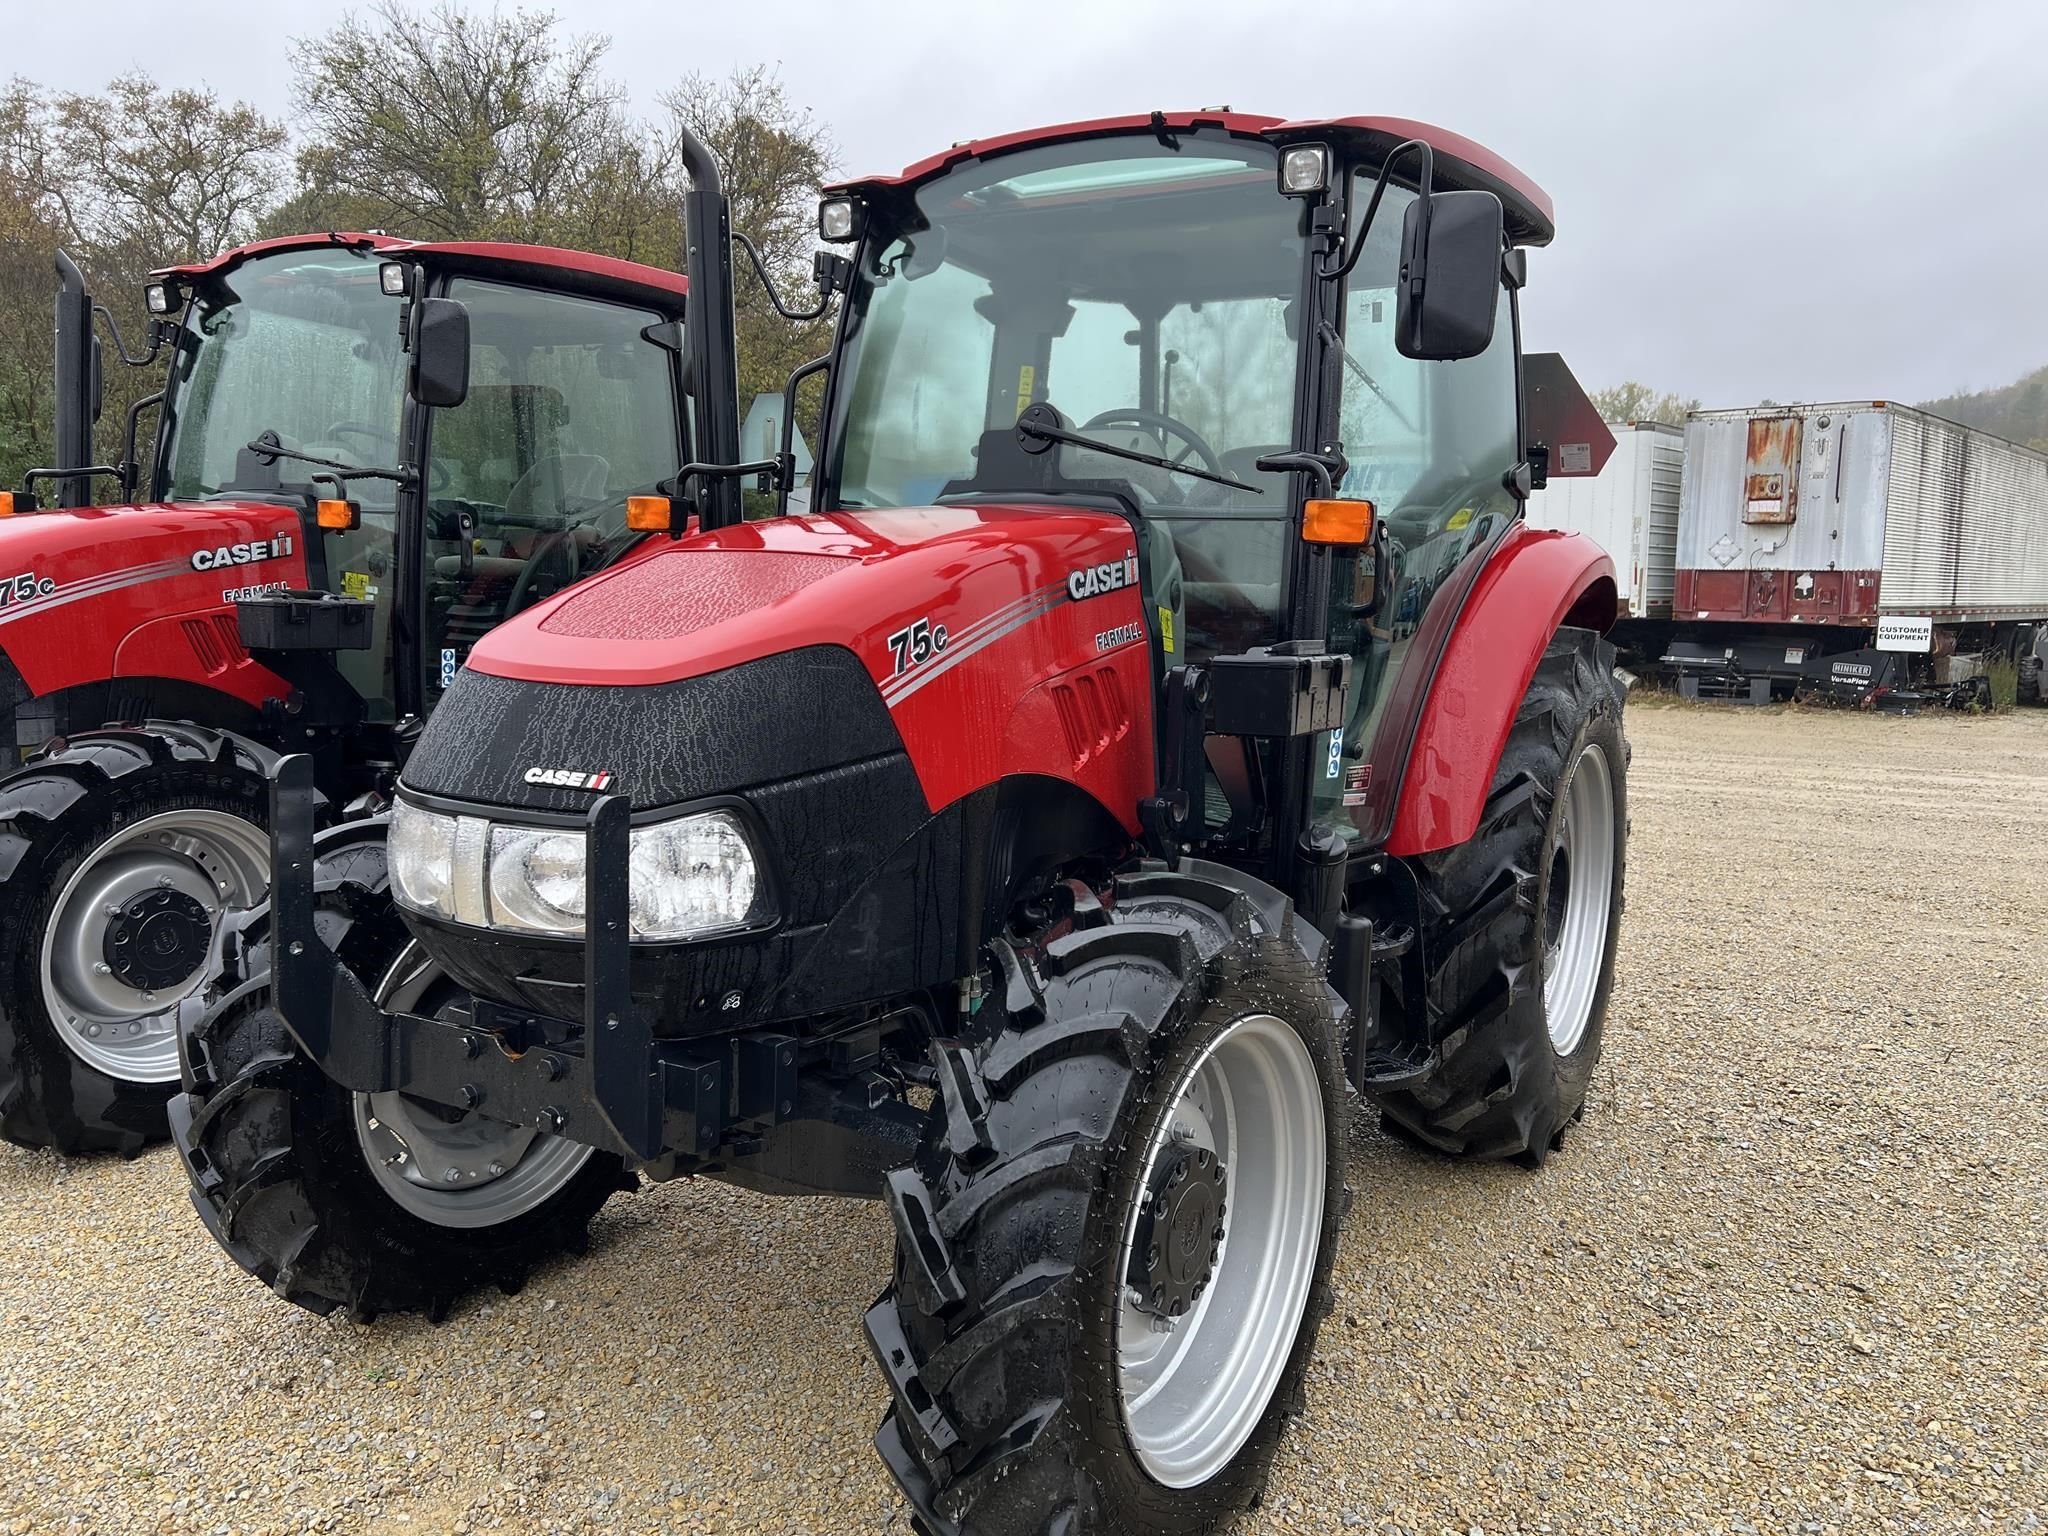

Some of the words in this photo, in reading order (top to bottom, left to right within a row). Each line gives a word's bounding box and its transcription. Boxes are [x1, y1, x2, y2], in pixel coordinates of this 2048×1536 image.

[191, 543, 267, 571] CASE
[1068, 564, 1123, 600] CASE
[1095, 622, 1143, 652] FARMALL
[1880, 626, 1929, 634] CUSTOMER
[1833, 664, 1869, 675] HINIKER
[1831, 675, 1869, 685] VersaPlow
[524, 767, 585, 787] CASE
